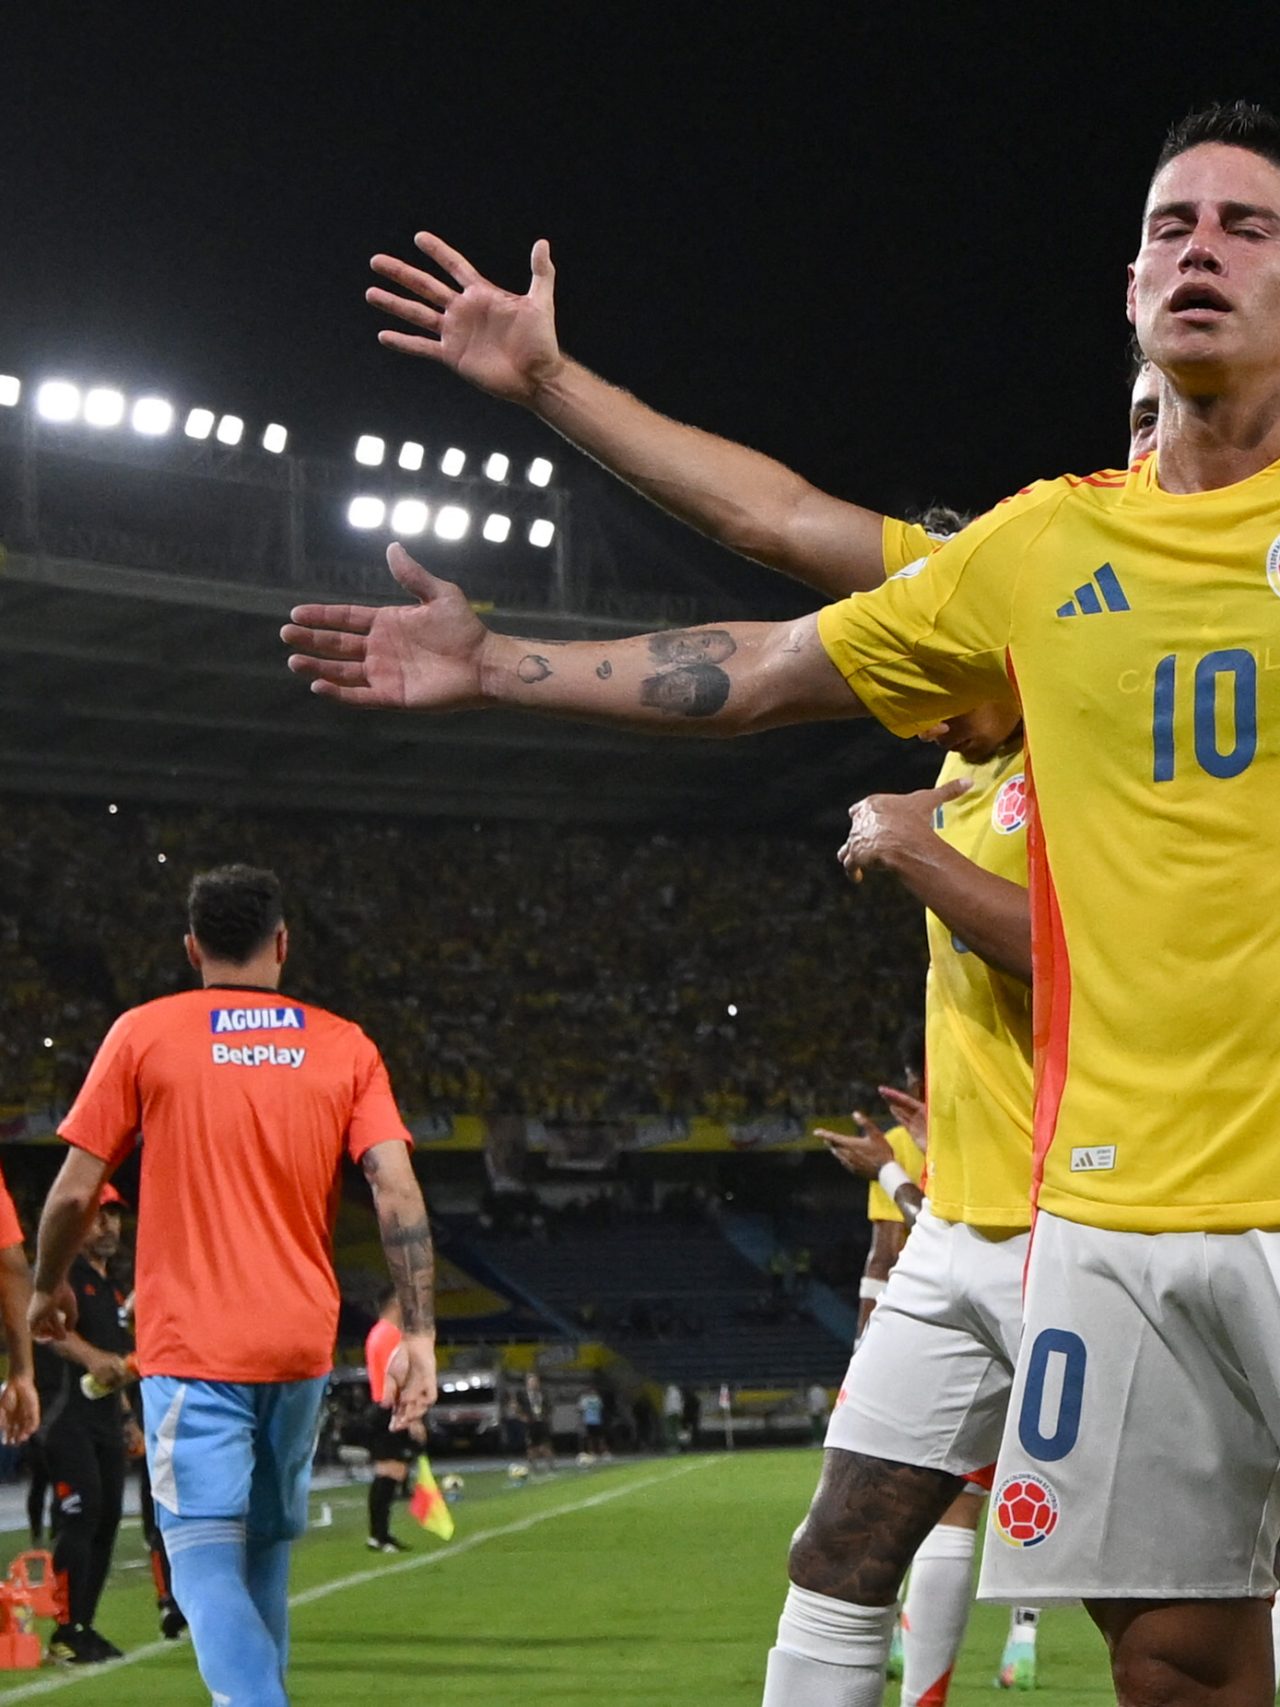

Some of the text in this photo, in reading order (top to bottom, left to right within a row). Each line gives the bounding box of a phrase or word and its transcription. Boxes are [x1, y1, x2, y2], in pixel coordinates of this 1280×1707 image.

[1152, 648, 1258, 783] 10
[211, 1042, 306, 1069] BetPlay
[214, 1007, 301, 1033] AGUILA
[1018, 1327, 1088, 1462] 0
